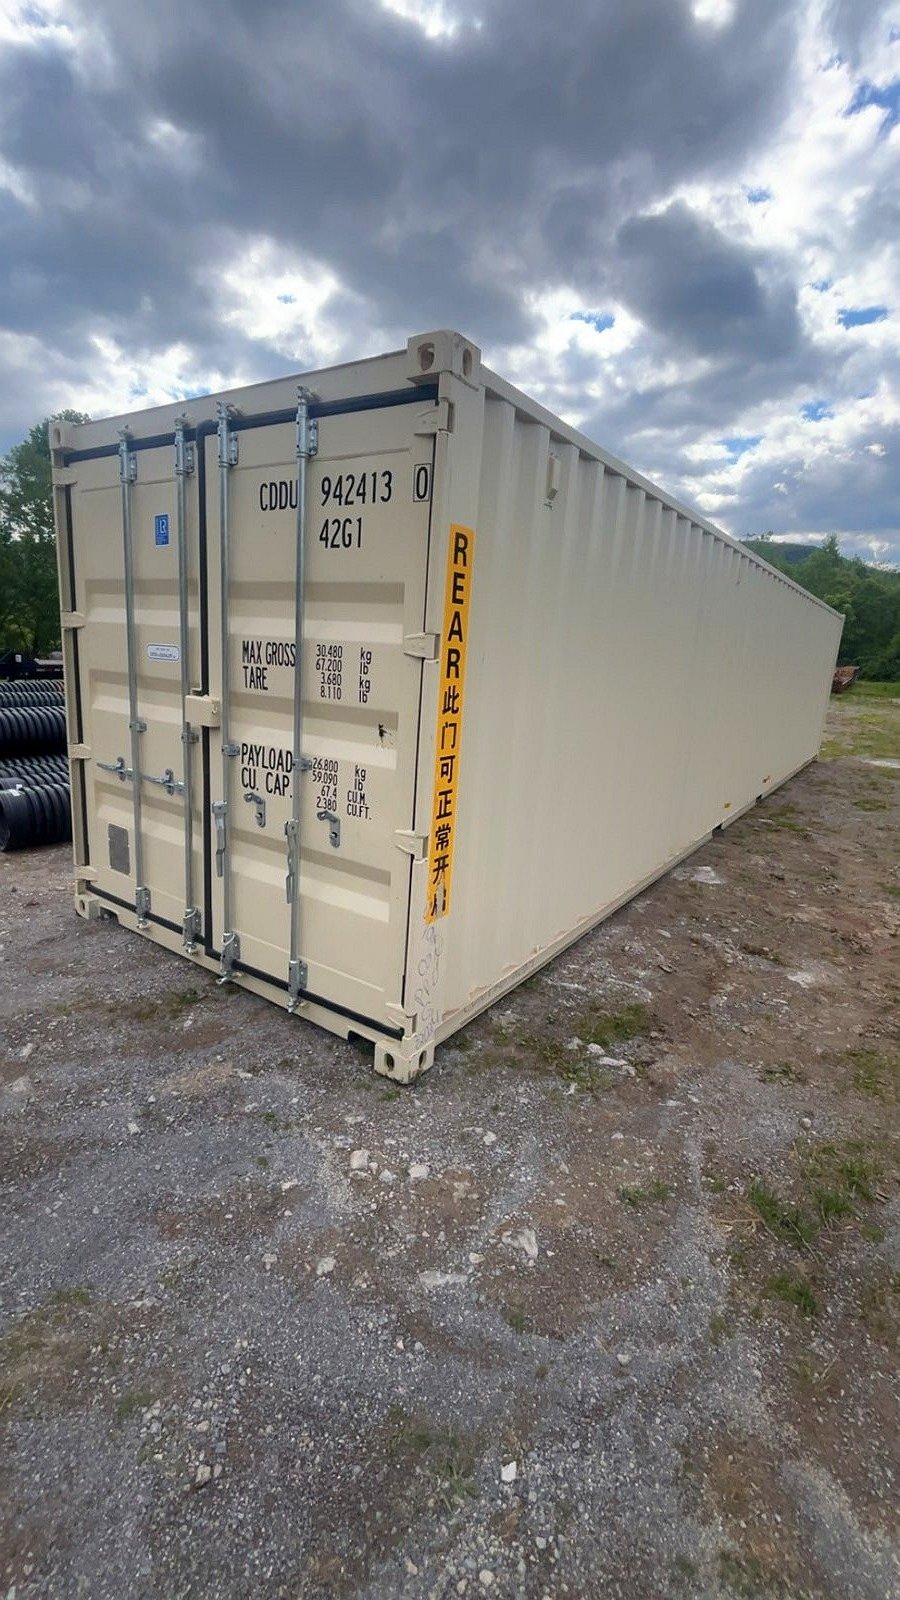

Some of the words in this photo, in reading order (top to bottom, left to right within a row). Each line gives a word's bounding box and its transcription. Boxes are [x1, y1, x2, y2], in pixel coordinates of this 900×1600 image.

[260, 480, 298, 511] CDDU
[321, 470, 392, 506] 942413
[416, 466, 428, 499] 0
[319, 517, 362, 549] 42G1
[446, 531, 469, 679] REAR
[242, 640, 262, 665] MAX
[265, 643, 296, 667] GROSS
[316, 644, 343, 659] 30.480
[360, 647, 372, 664] kg
[315, 657, 342, 673] 67.200
[359, 662, 368, 676] lb
[243, 667, 268, 691] TARE
[320, 672, 342, 687] 3.680
[359, 676, 370, 693] kg
[320, 686, 342, 701] 8.110
[359, 690, 367, 703] lb
[241, 743, 293, 774] PAYLOAD
[312, 758, 339, 773] 26.800
[354, 765, 366, 782] kg
[241, 767, 259, 791] CU.
[265, 772, 293, 799] CAP.
[320, 785, 337, 799] 67.4
[312, 770, 338, 786] 59.090
[354, 778, 363, 791] lb
